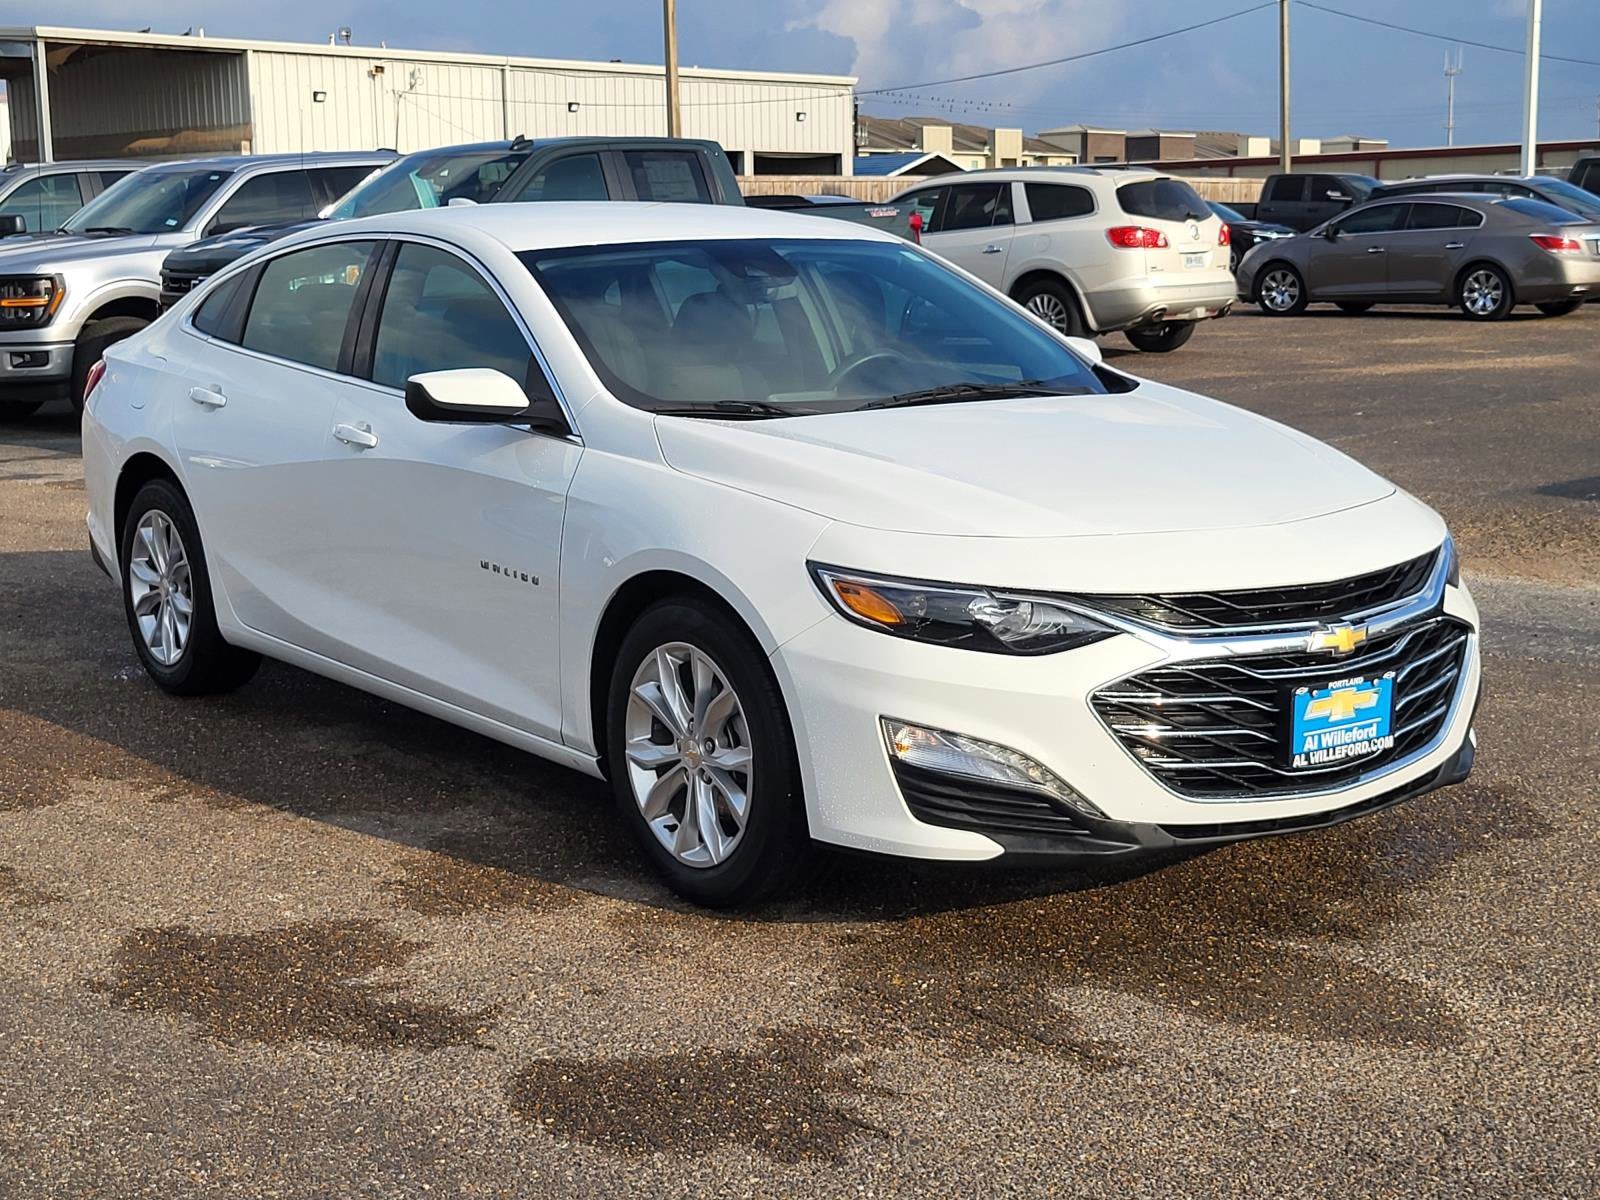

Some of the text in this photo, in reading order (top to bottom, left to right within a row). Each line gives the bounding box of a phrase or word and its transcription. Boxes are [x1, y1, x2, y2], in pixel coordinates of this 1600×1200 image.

[480, 560, 540, 586] MALIBU
[1328, 677, 1364, 690] PORTLAND
[1303, 723, 1377, 752] Al Willeford
[1293, 735, 1394, 768] AL WILLEFORD.COM
